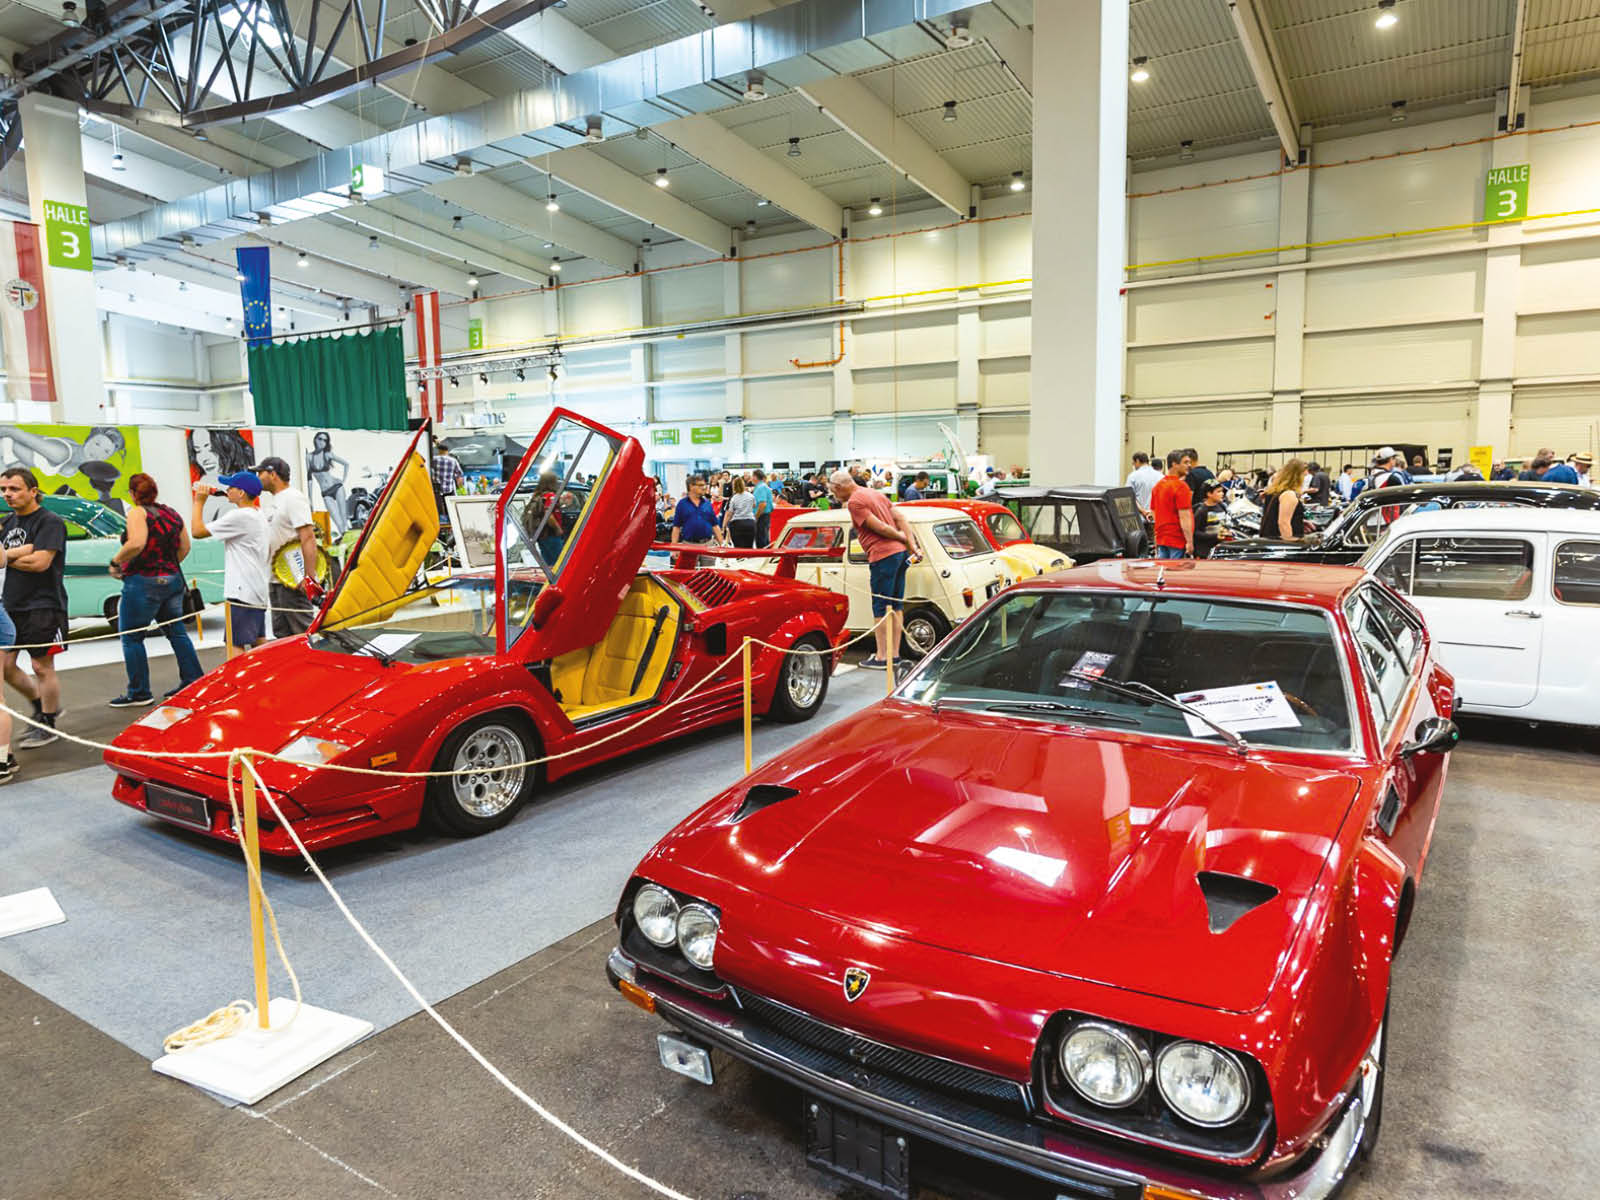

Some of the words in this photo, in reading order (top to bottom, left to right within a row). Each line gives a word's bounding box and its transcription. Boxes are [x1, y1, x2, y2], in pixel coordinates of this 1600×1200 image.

[1488, 166, 1529, 186] HALLE
[45, 203, 87, 227] HALLE
[1497, 189, 1517, 217] 3
[61, 231, 80, 258] 3
[473, 331, 480, 346] 3
